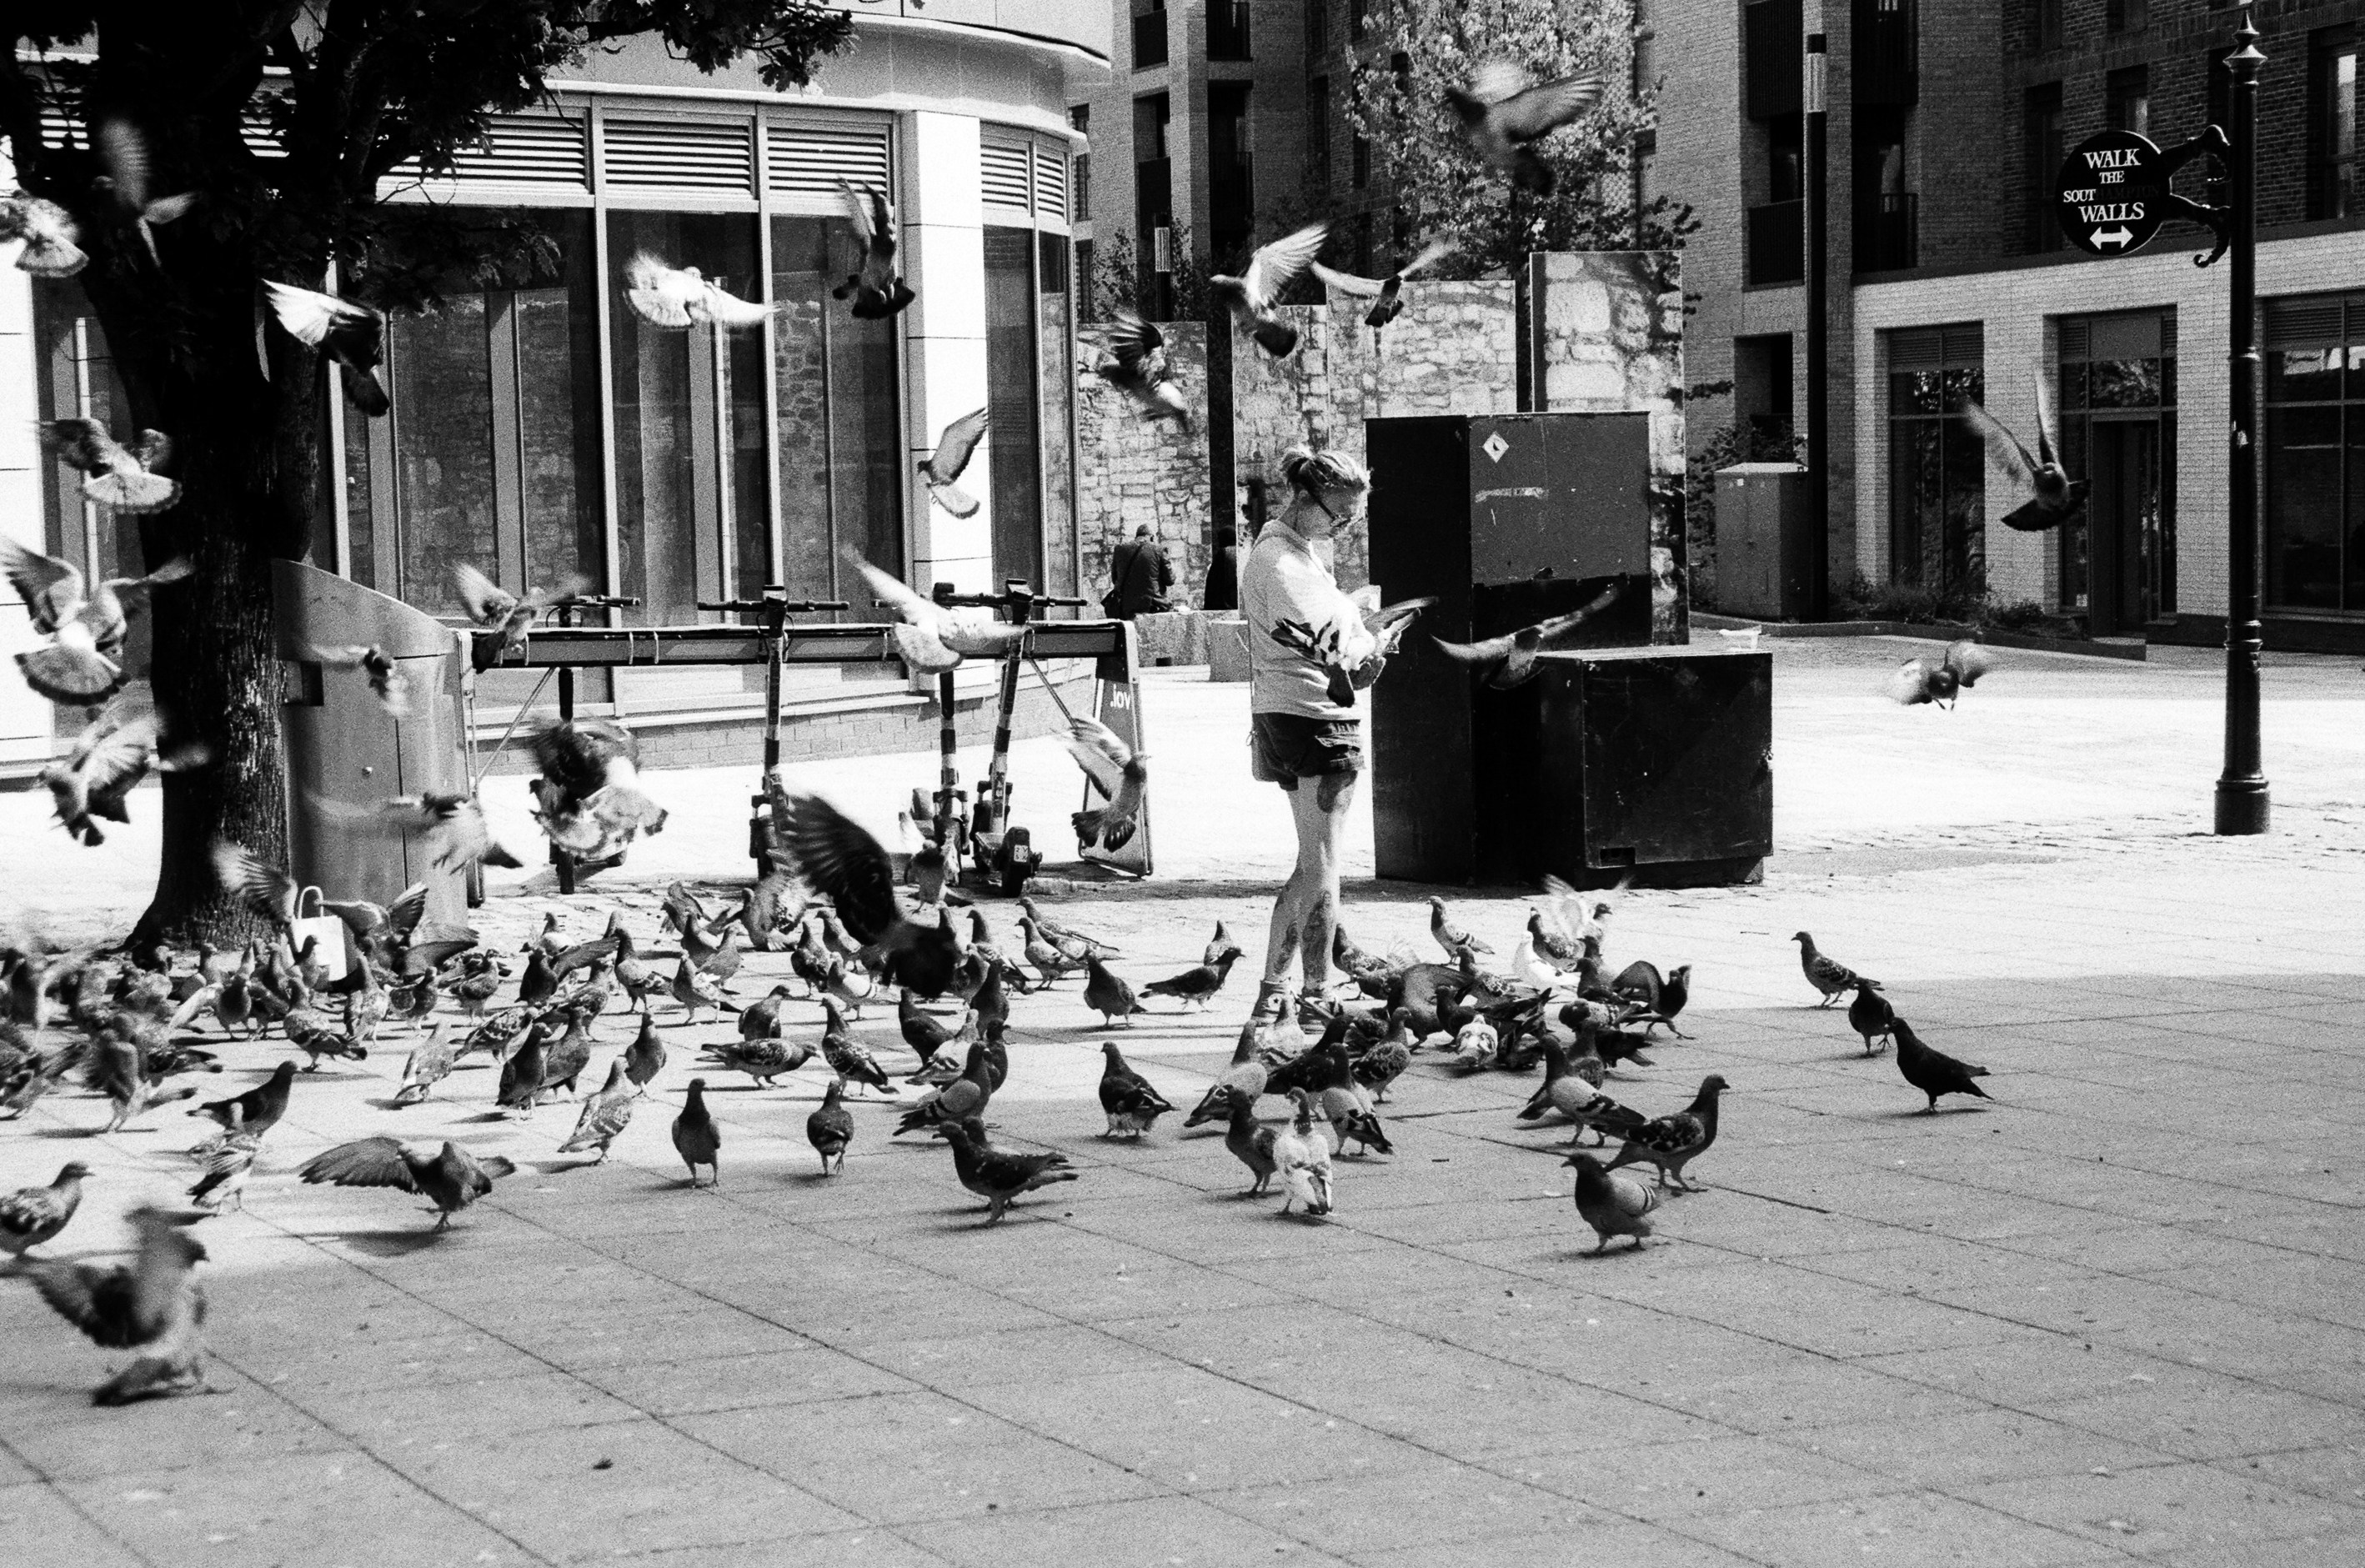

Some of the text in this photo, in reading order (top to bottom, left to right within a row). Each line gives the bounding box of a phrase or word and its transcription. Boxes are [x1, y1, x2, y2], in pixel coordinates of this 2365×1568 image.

[2082, 148, 2142, 169] WALK
[2099, 171, 2125, 184] THE
[2078, 203, 2145, 223] WALLS
